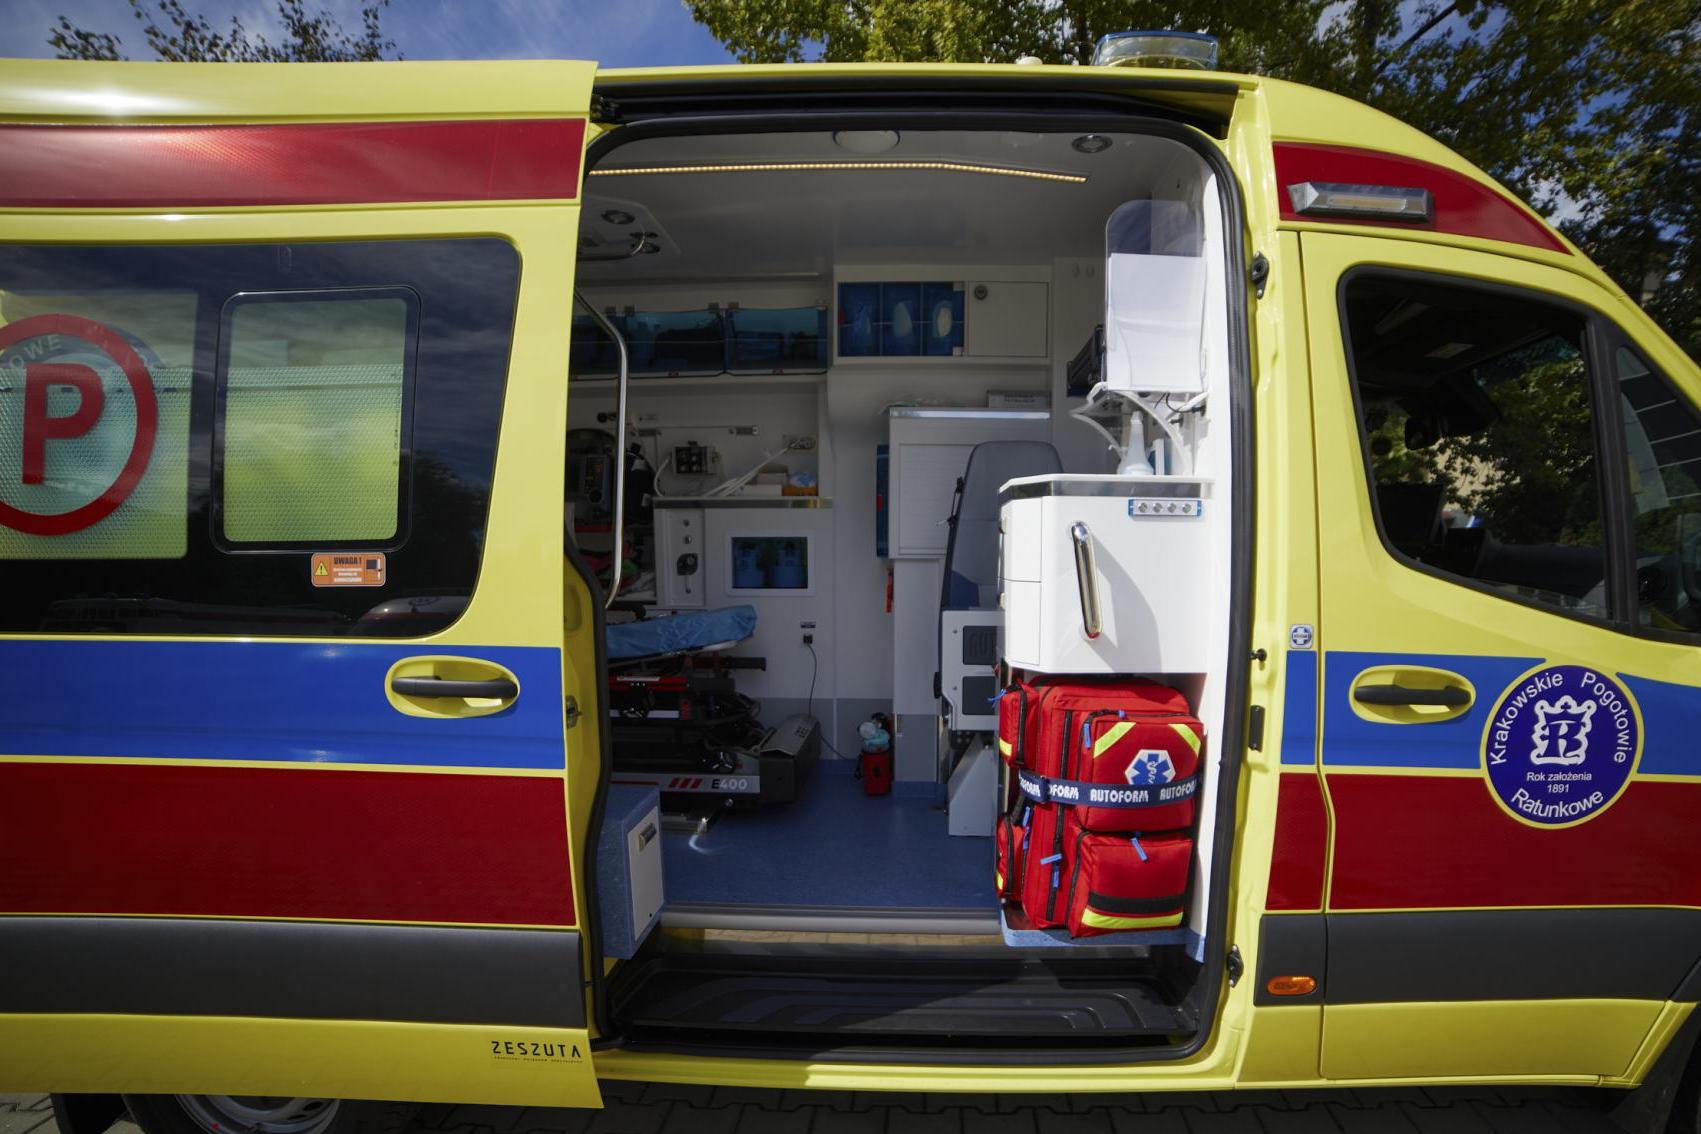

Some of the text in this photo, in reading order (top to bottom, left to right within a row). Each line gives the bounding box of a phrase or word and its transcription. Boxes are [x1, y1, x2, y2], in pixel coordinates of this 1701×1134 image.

[22, 363, 104, 485] P
[1490, 671, 1633, 766] Krakowskie Pogotowie
[711, 778, 748, 790] E400
[1526, 771, 1593, 782] Rok założenia
[1090, 788, 1149, 803] AUTOFORM
[1546, 783, 1570, 793] 1891
[1511, 787, 1604, 818] Ratunkowe
[491, 1041, 582, 1058] ZESZUTA
